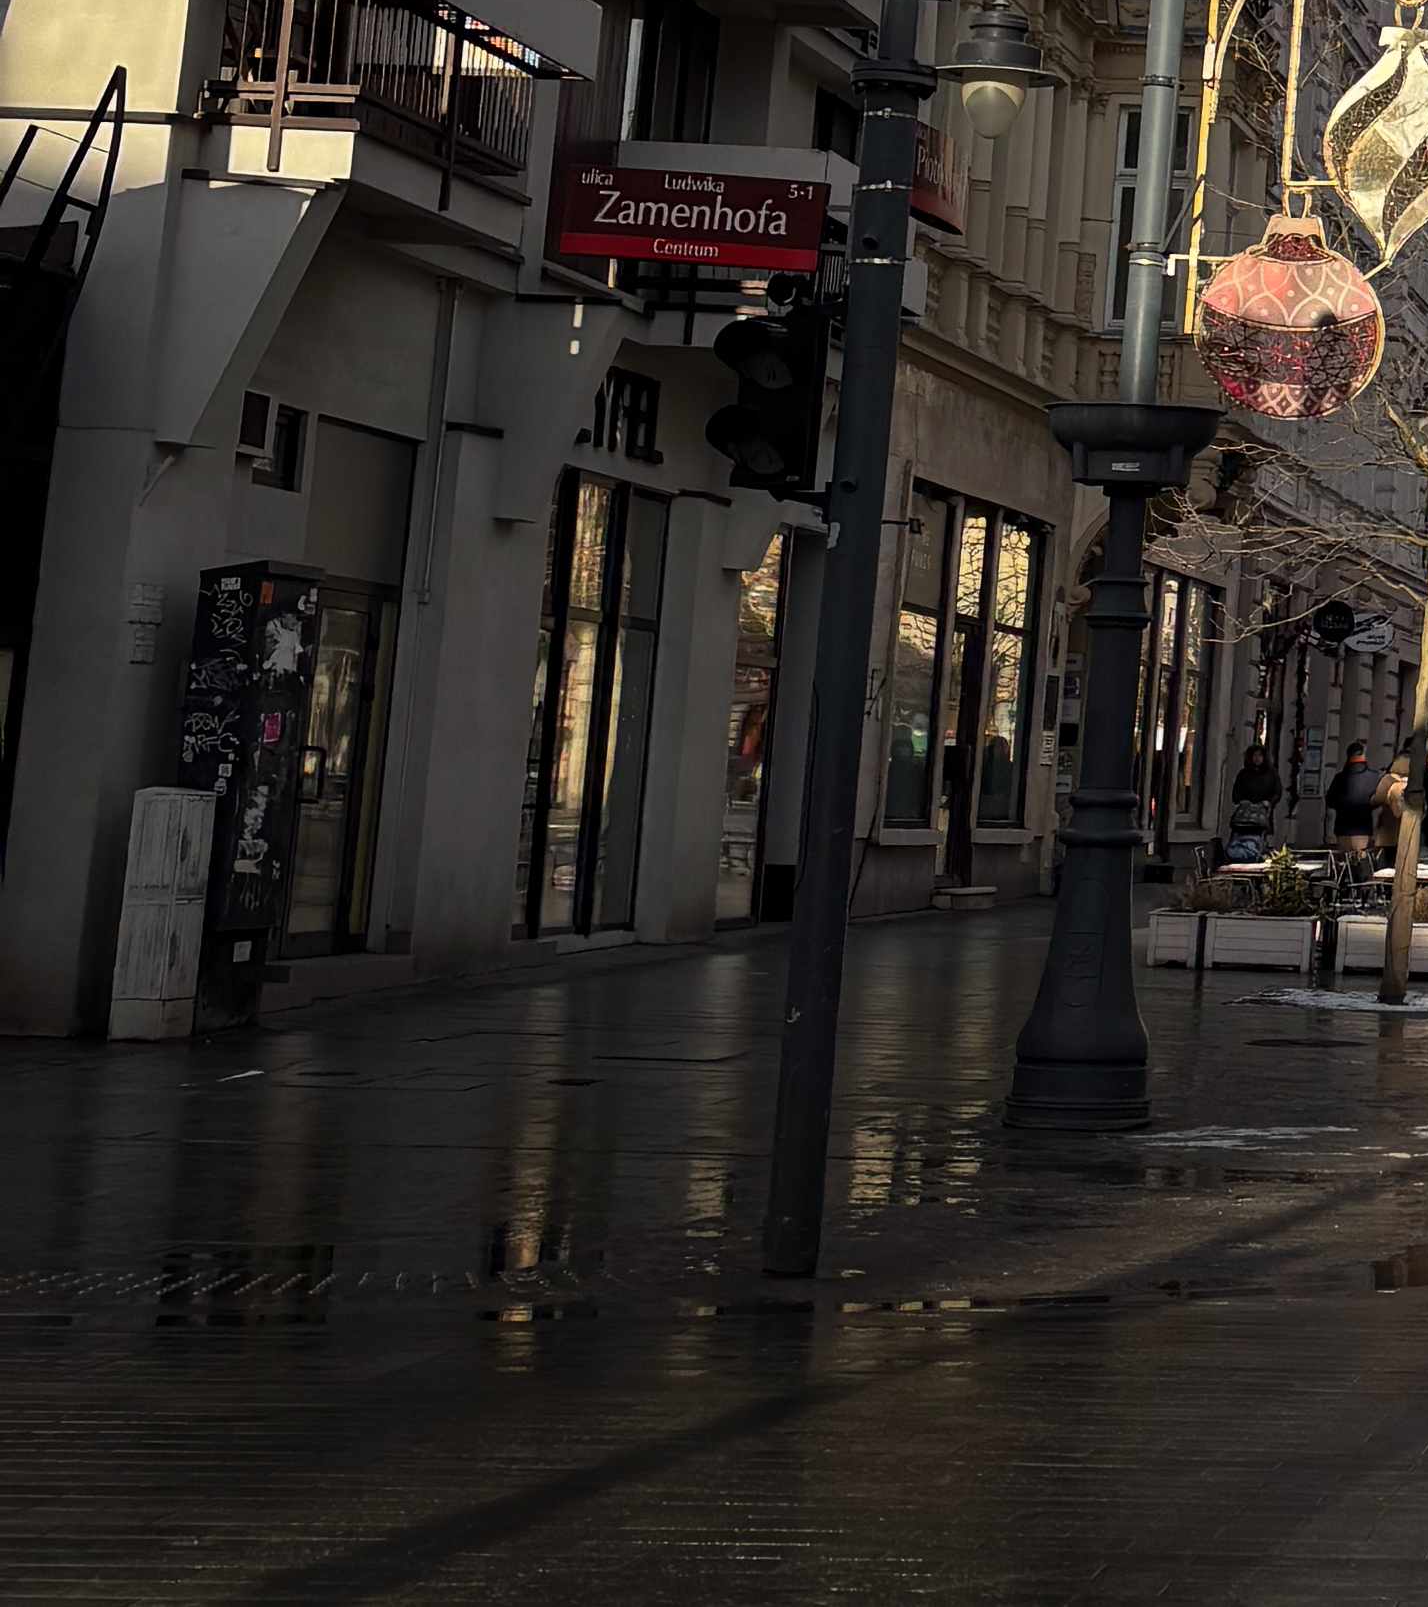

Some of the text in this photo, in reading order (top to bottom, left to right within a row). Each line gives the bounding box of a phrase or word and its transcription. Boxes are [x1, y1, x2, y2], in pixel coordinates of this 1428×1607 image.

[581, 168, 614, 186] ulica
[664, 173, 726, 193] Ludwika
[593, 190, 787, 235] Zamenhofa
[652, 238, 719, 258] Centrum
